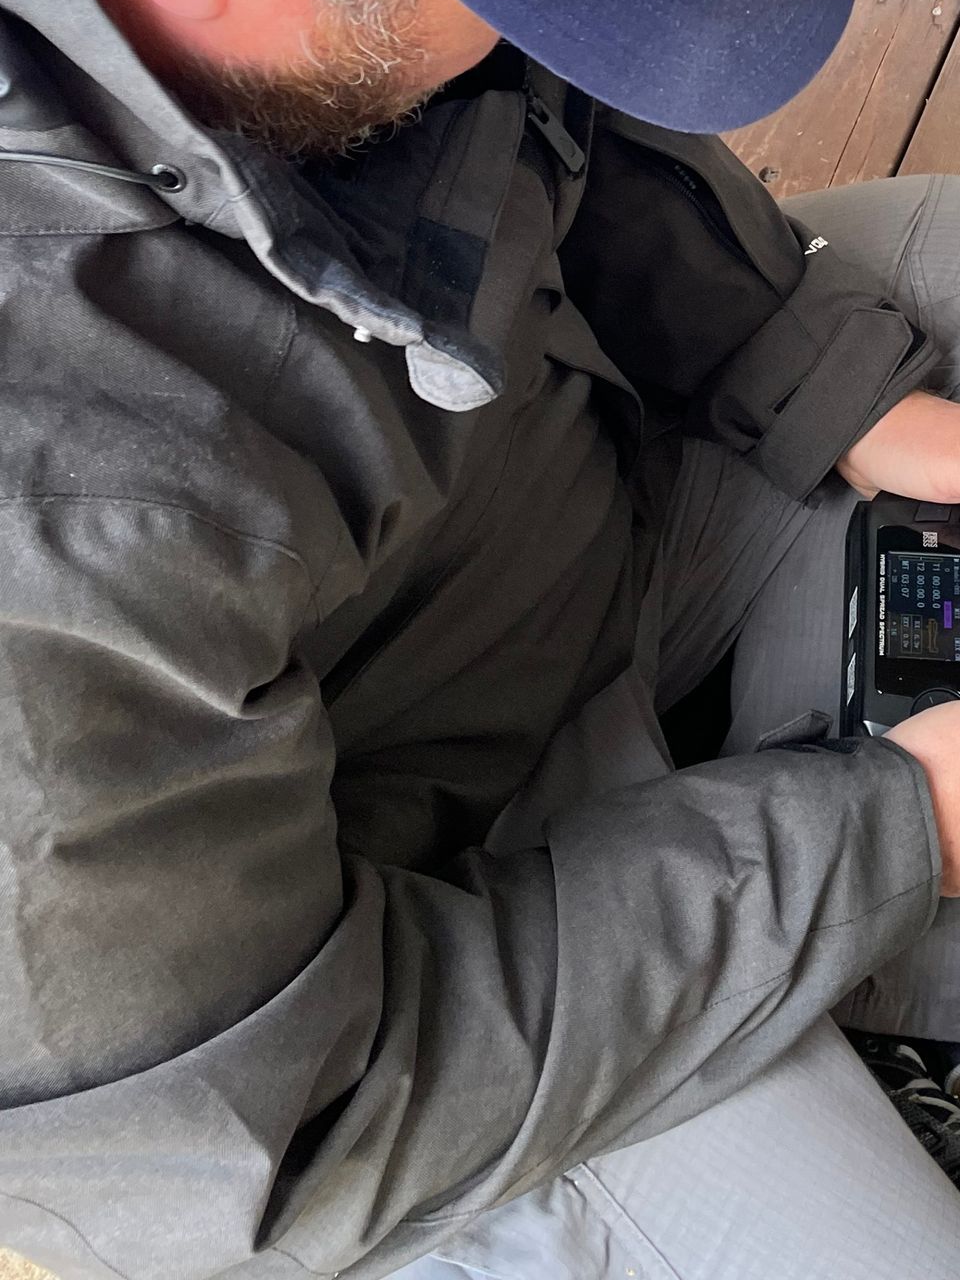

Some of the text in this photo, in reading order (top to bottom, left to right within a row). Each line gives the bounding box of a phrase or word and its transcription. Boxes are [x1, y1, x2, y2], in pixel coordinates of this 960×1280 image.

[917, 562, 925, 571] T2
[932, 563, 940, 571] T1
[901, 560, 909, 598] MT 03:07
